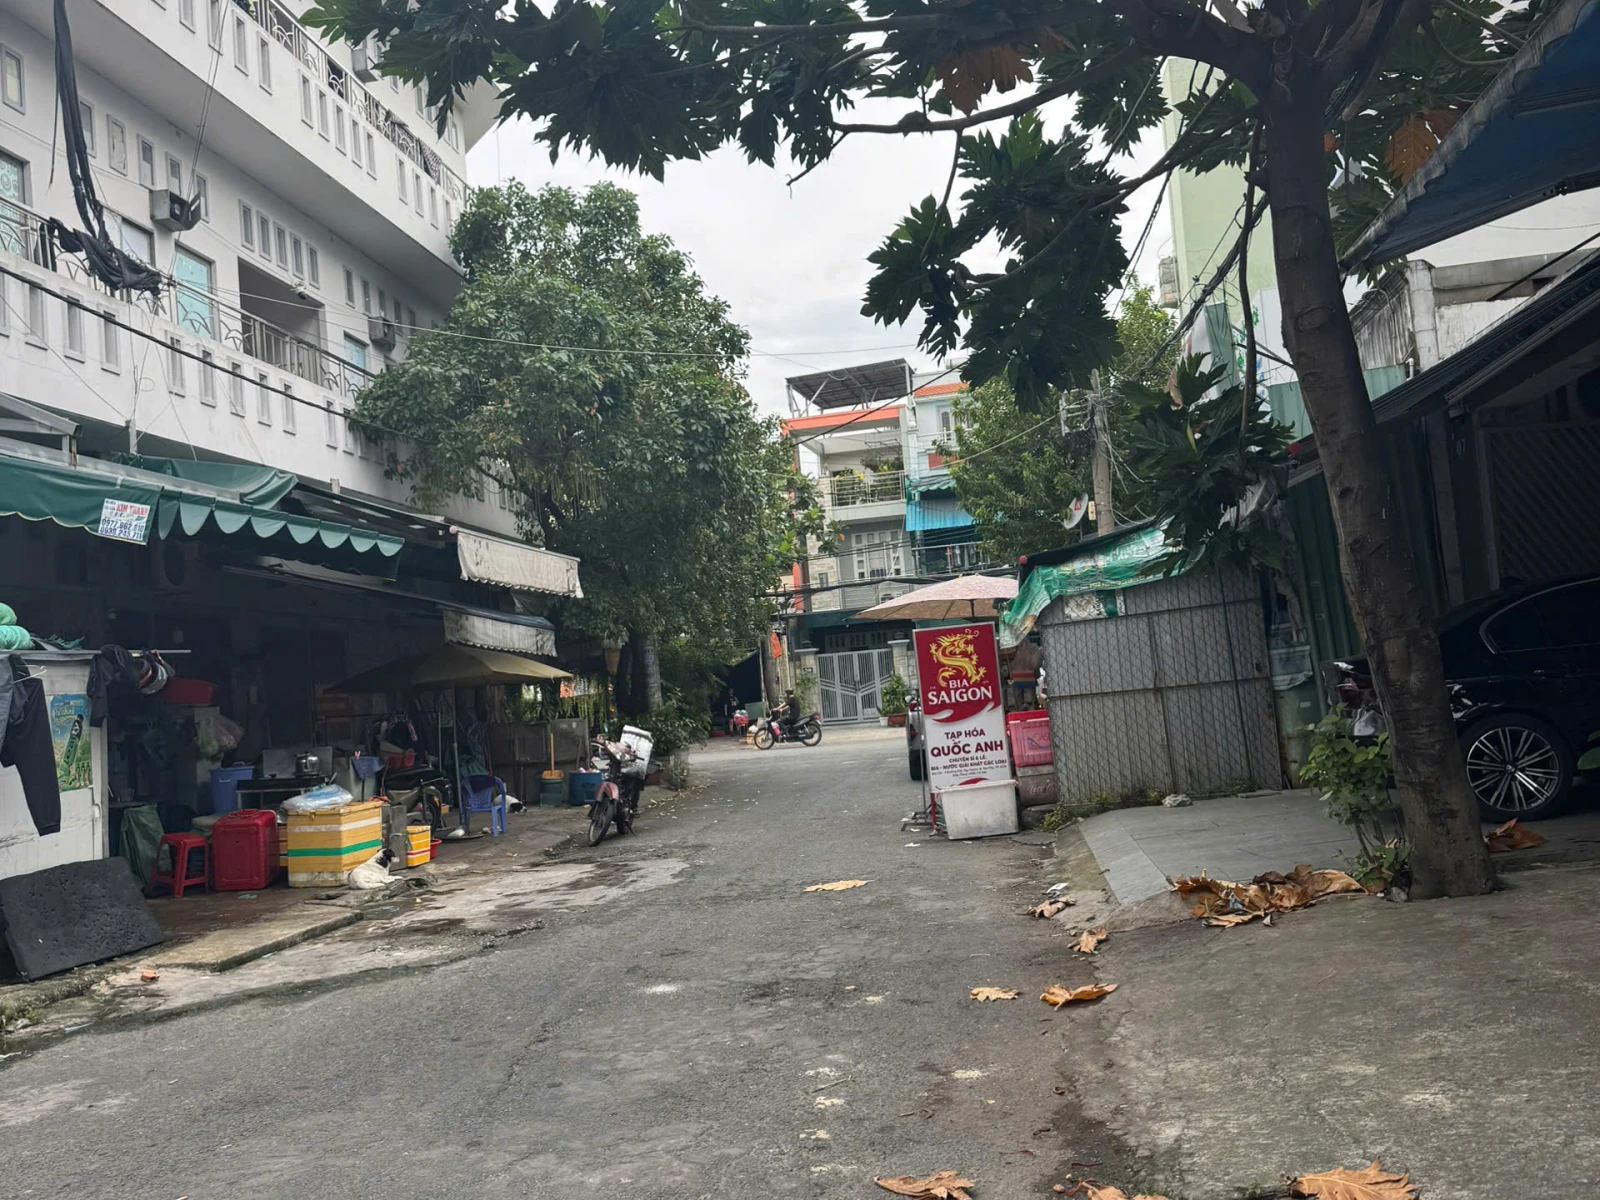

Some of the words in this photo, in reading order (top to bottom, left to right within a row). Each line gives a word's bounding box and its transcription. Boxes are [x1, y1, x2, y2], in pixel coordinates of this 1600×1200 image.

[949, 679, 969, 688] BIA
[927, 685, 993, 705] SAIGON
[944, 730, 963, 741] TẠP
[964, 727, 986, 738] HÓA
[930, 740, 971, 757] QUỐC
[975, 740, 1004, 753] ANH
